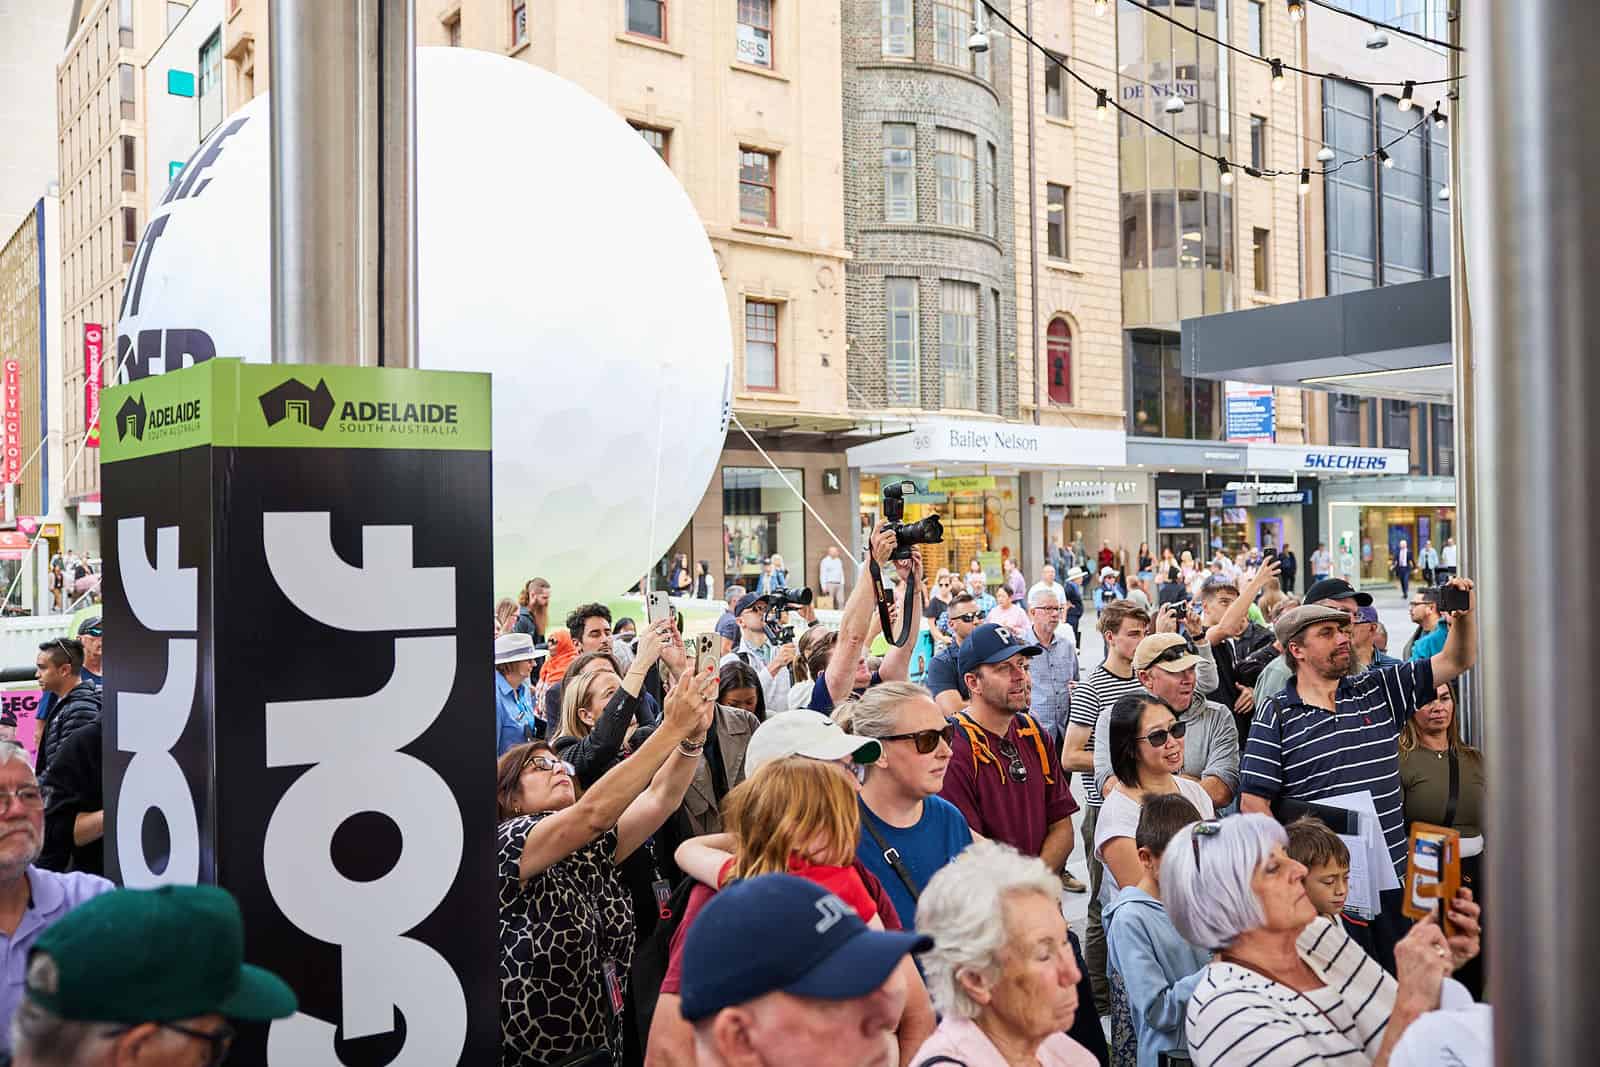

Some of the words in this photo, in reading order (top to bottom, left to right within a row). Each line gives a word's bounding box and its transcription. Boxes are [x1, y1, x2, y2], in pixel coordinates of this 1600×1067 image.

[6, 361, 17, 408] CITY
[148, 399, 201, 430] ADELAIDE
[340, 401, 458, 424] ADELAIDE
[339, 423, 384, 434] SOUTH
[389, 424, 458, 435] AUSTRALIA
[949, 430, 990, 452] Bailey
[994, 431, 1038, 451] Nelson
[1304, 453, 1388, 469] SKECHERS
[116, 516, 199, 889] OLF
